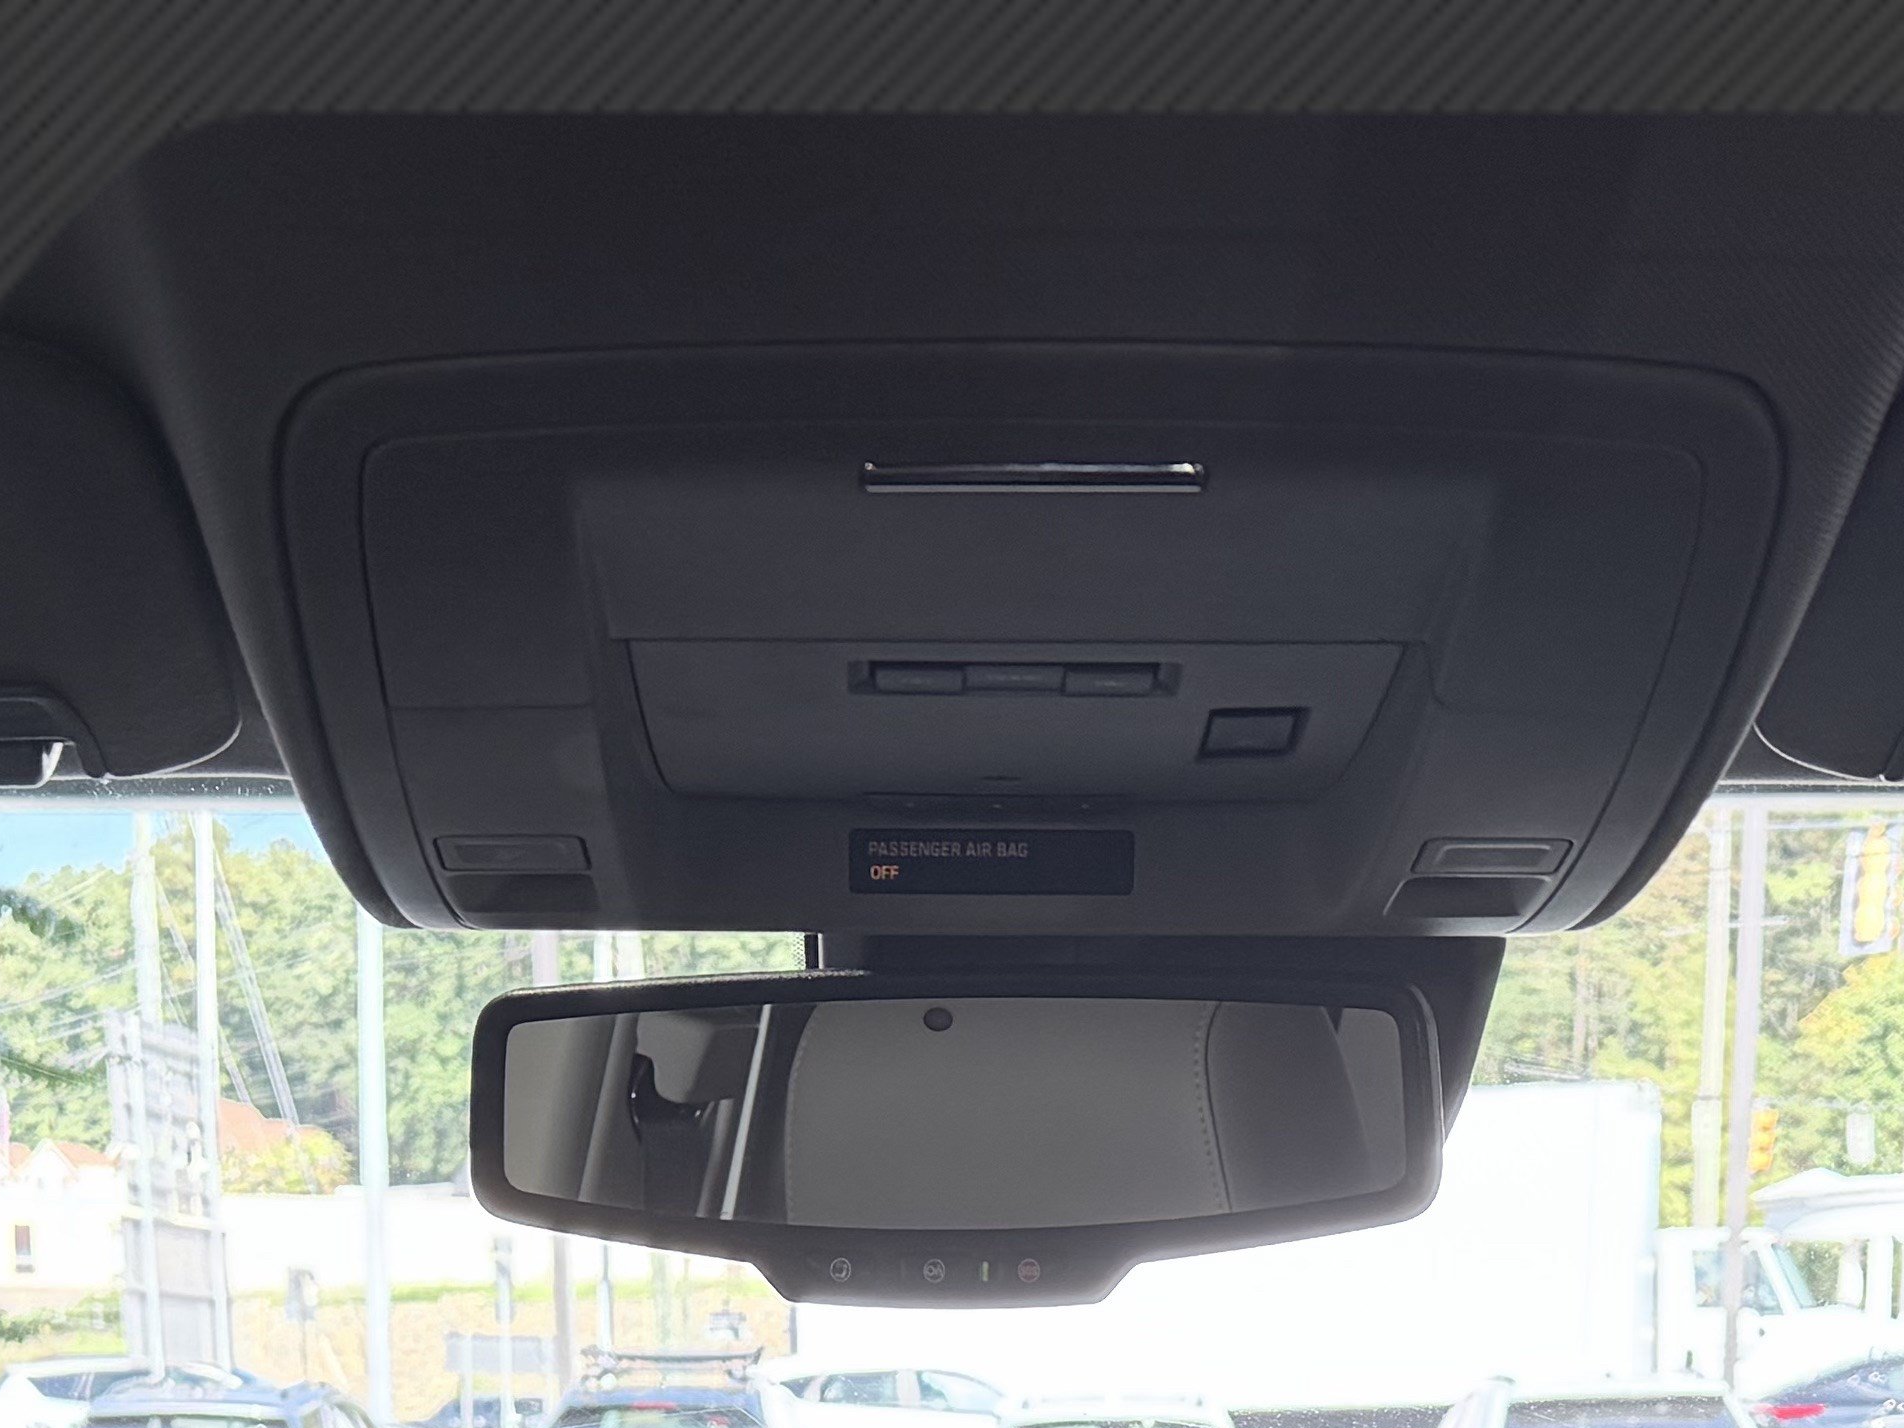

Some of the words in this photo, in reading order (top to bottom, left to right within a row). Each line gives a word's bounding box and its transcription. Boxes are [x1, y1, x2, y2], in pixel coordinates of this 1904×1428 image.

[868, 841, 961, 858] PASSENGER
[965, 841, 993, 858] AIR
[996, 842, 1029, 859] BAG
[869, 864, 900, 881] OFF
